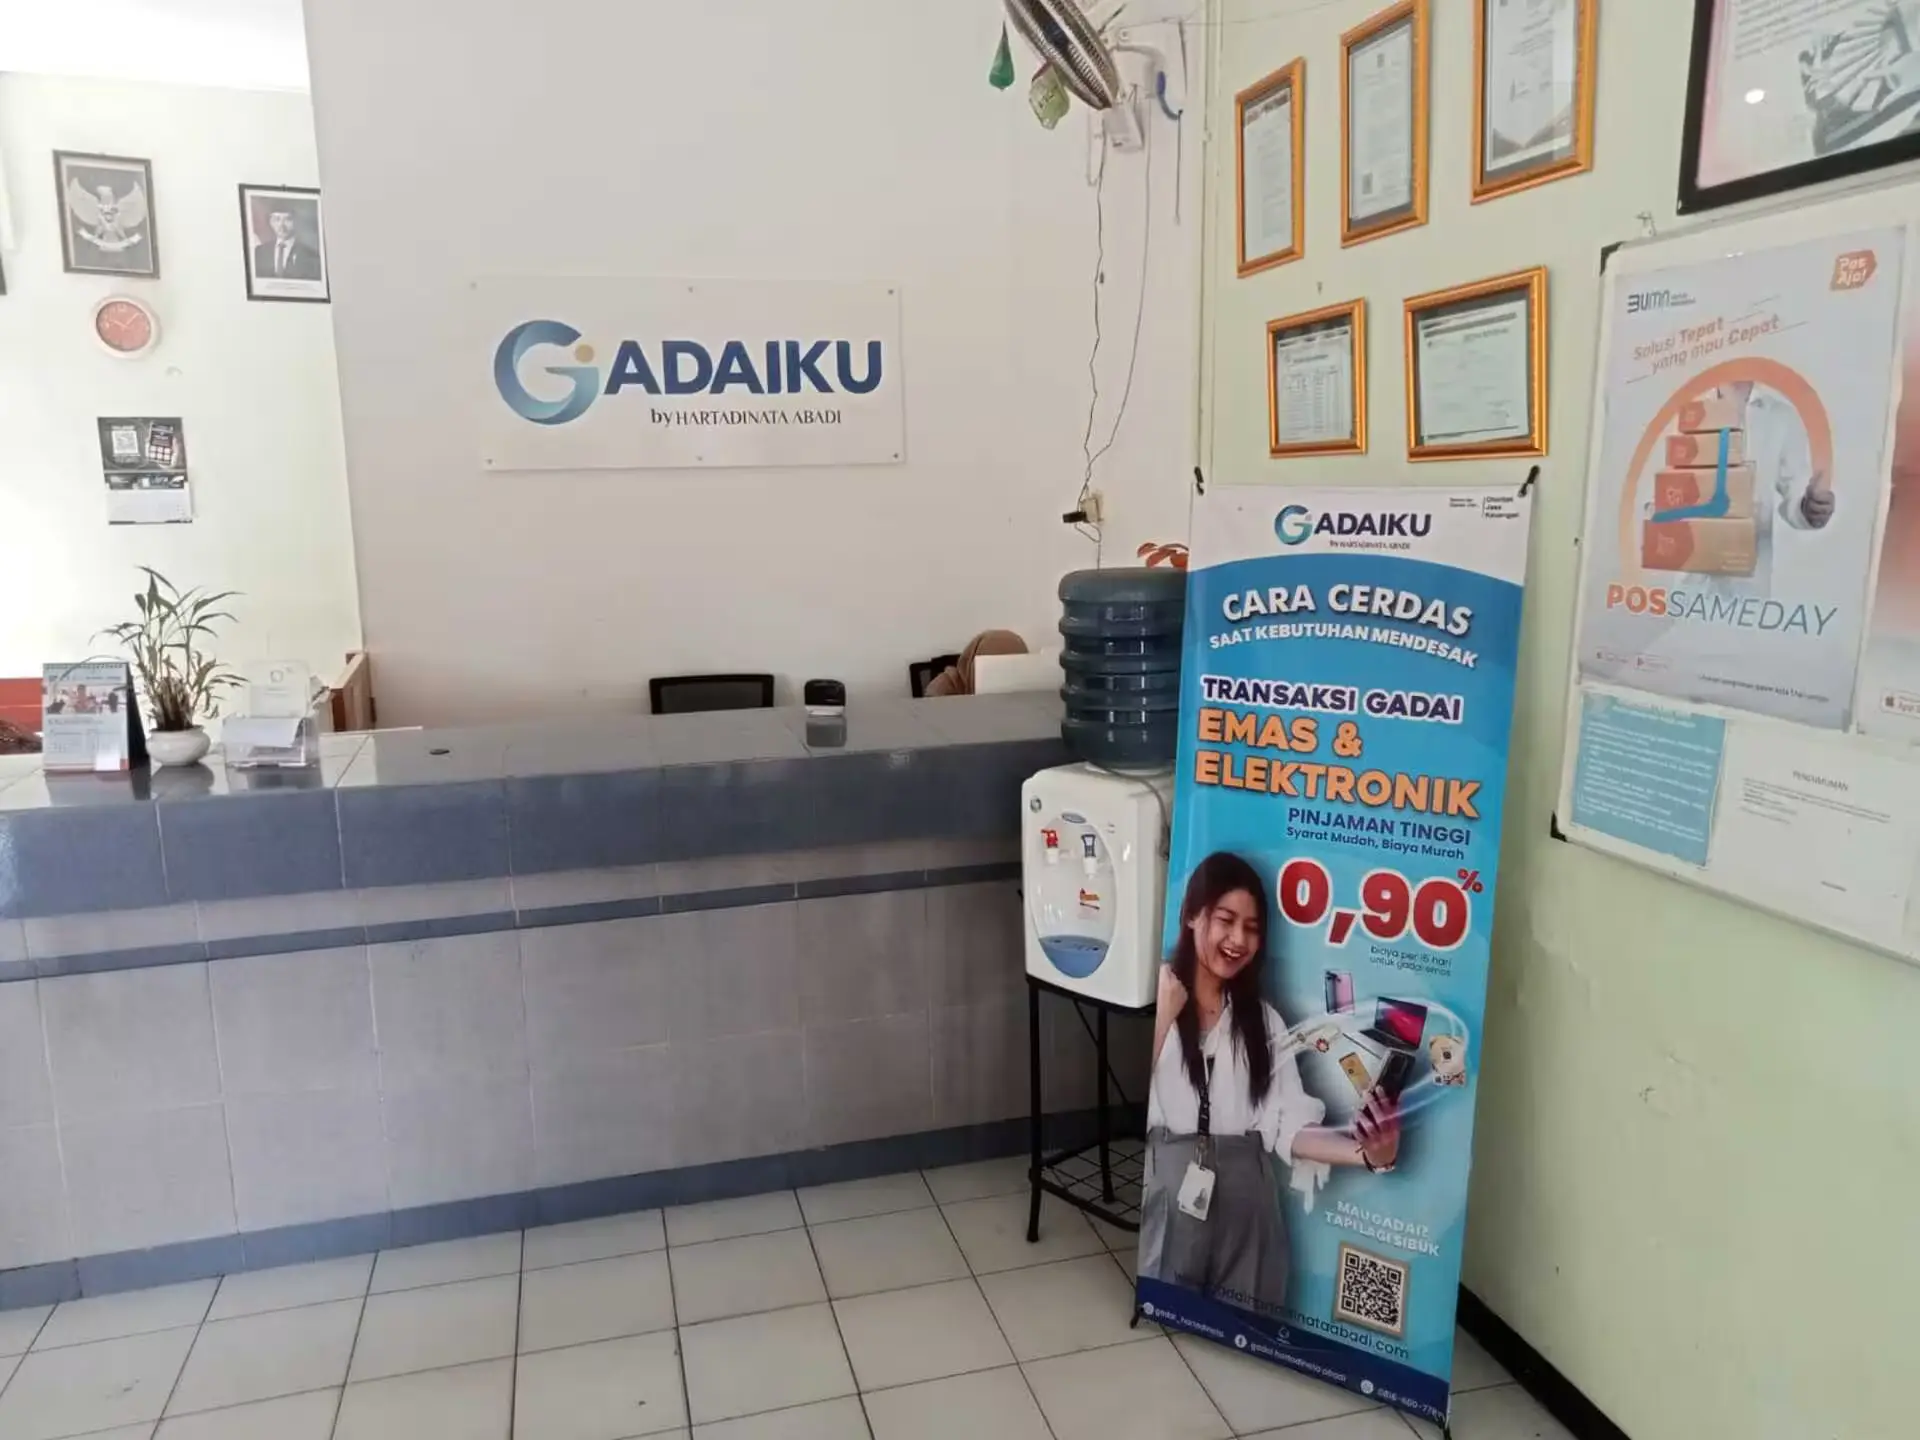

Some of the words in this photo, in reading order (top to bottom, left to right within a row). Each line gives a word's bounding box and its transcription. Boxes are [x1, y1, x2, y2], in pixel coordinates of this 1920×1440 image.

[1633, 336, 1676, 361] Solusi
[1679, 316, 1725, 345] Tepat
[1652, 350, 1688, 375] yang
[1690, 338, 1725, 359] mau
[1728, 313, 1781, 345] Cepat
[494, 319, 882, 426] GADAIKU
[651, 408, 674, 428] by
[676, 409, 788, 426] HARTADINATA
[793, 409, 842, 425] ABADI
[1274, 504, 1432, 545] GADAIKU
[1222, 584, 1317, 622] CARA
[1328, 583, 1474, 636] CERDAS
[1209, 626, 1253, 650] SAAT
[1255, 622, 1370, 642] KEBUTUHAN
[1371, 628, 1479, 669] MENDESAK
[1202, 676, 1357, 712] TRANSAKSI
[1365, 690, 1462, 722] GADAI
[1197, 706, 1320, 754] EMAS
[1332, 720, 1364, 758] &
[1194, 749, 1482, 820] ELEKTRONIK
[1287, 826, 1328, 843] Syarat
[1331, 829, 1379, 849] Mudah,
[1382, 839, 1418, 855] Biaya
[1421, 843, 1465, 861] Murah
[1288, 807, 1395, 835] PINJAMAN
[1400, 821, 1471, 846] TINGGI
[1370, 945, 1399, 958] biaya
[1432, 955, 1452, 968] hari
[1324, 1210, 1358, 1230] TAPI
[1359, 1223, 1392, 1243] LAGI
[1393, 1235, 1440, 1257] SIBUK
